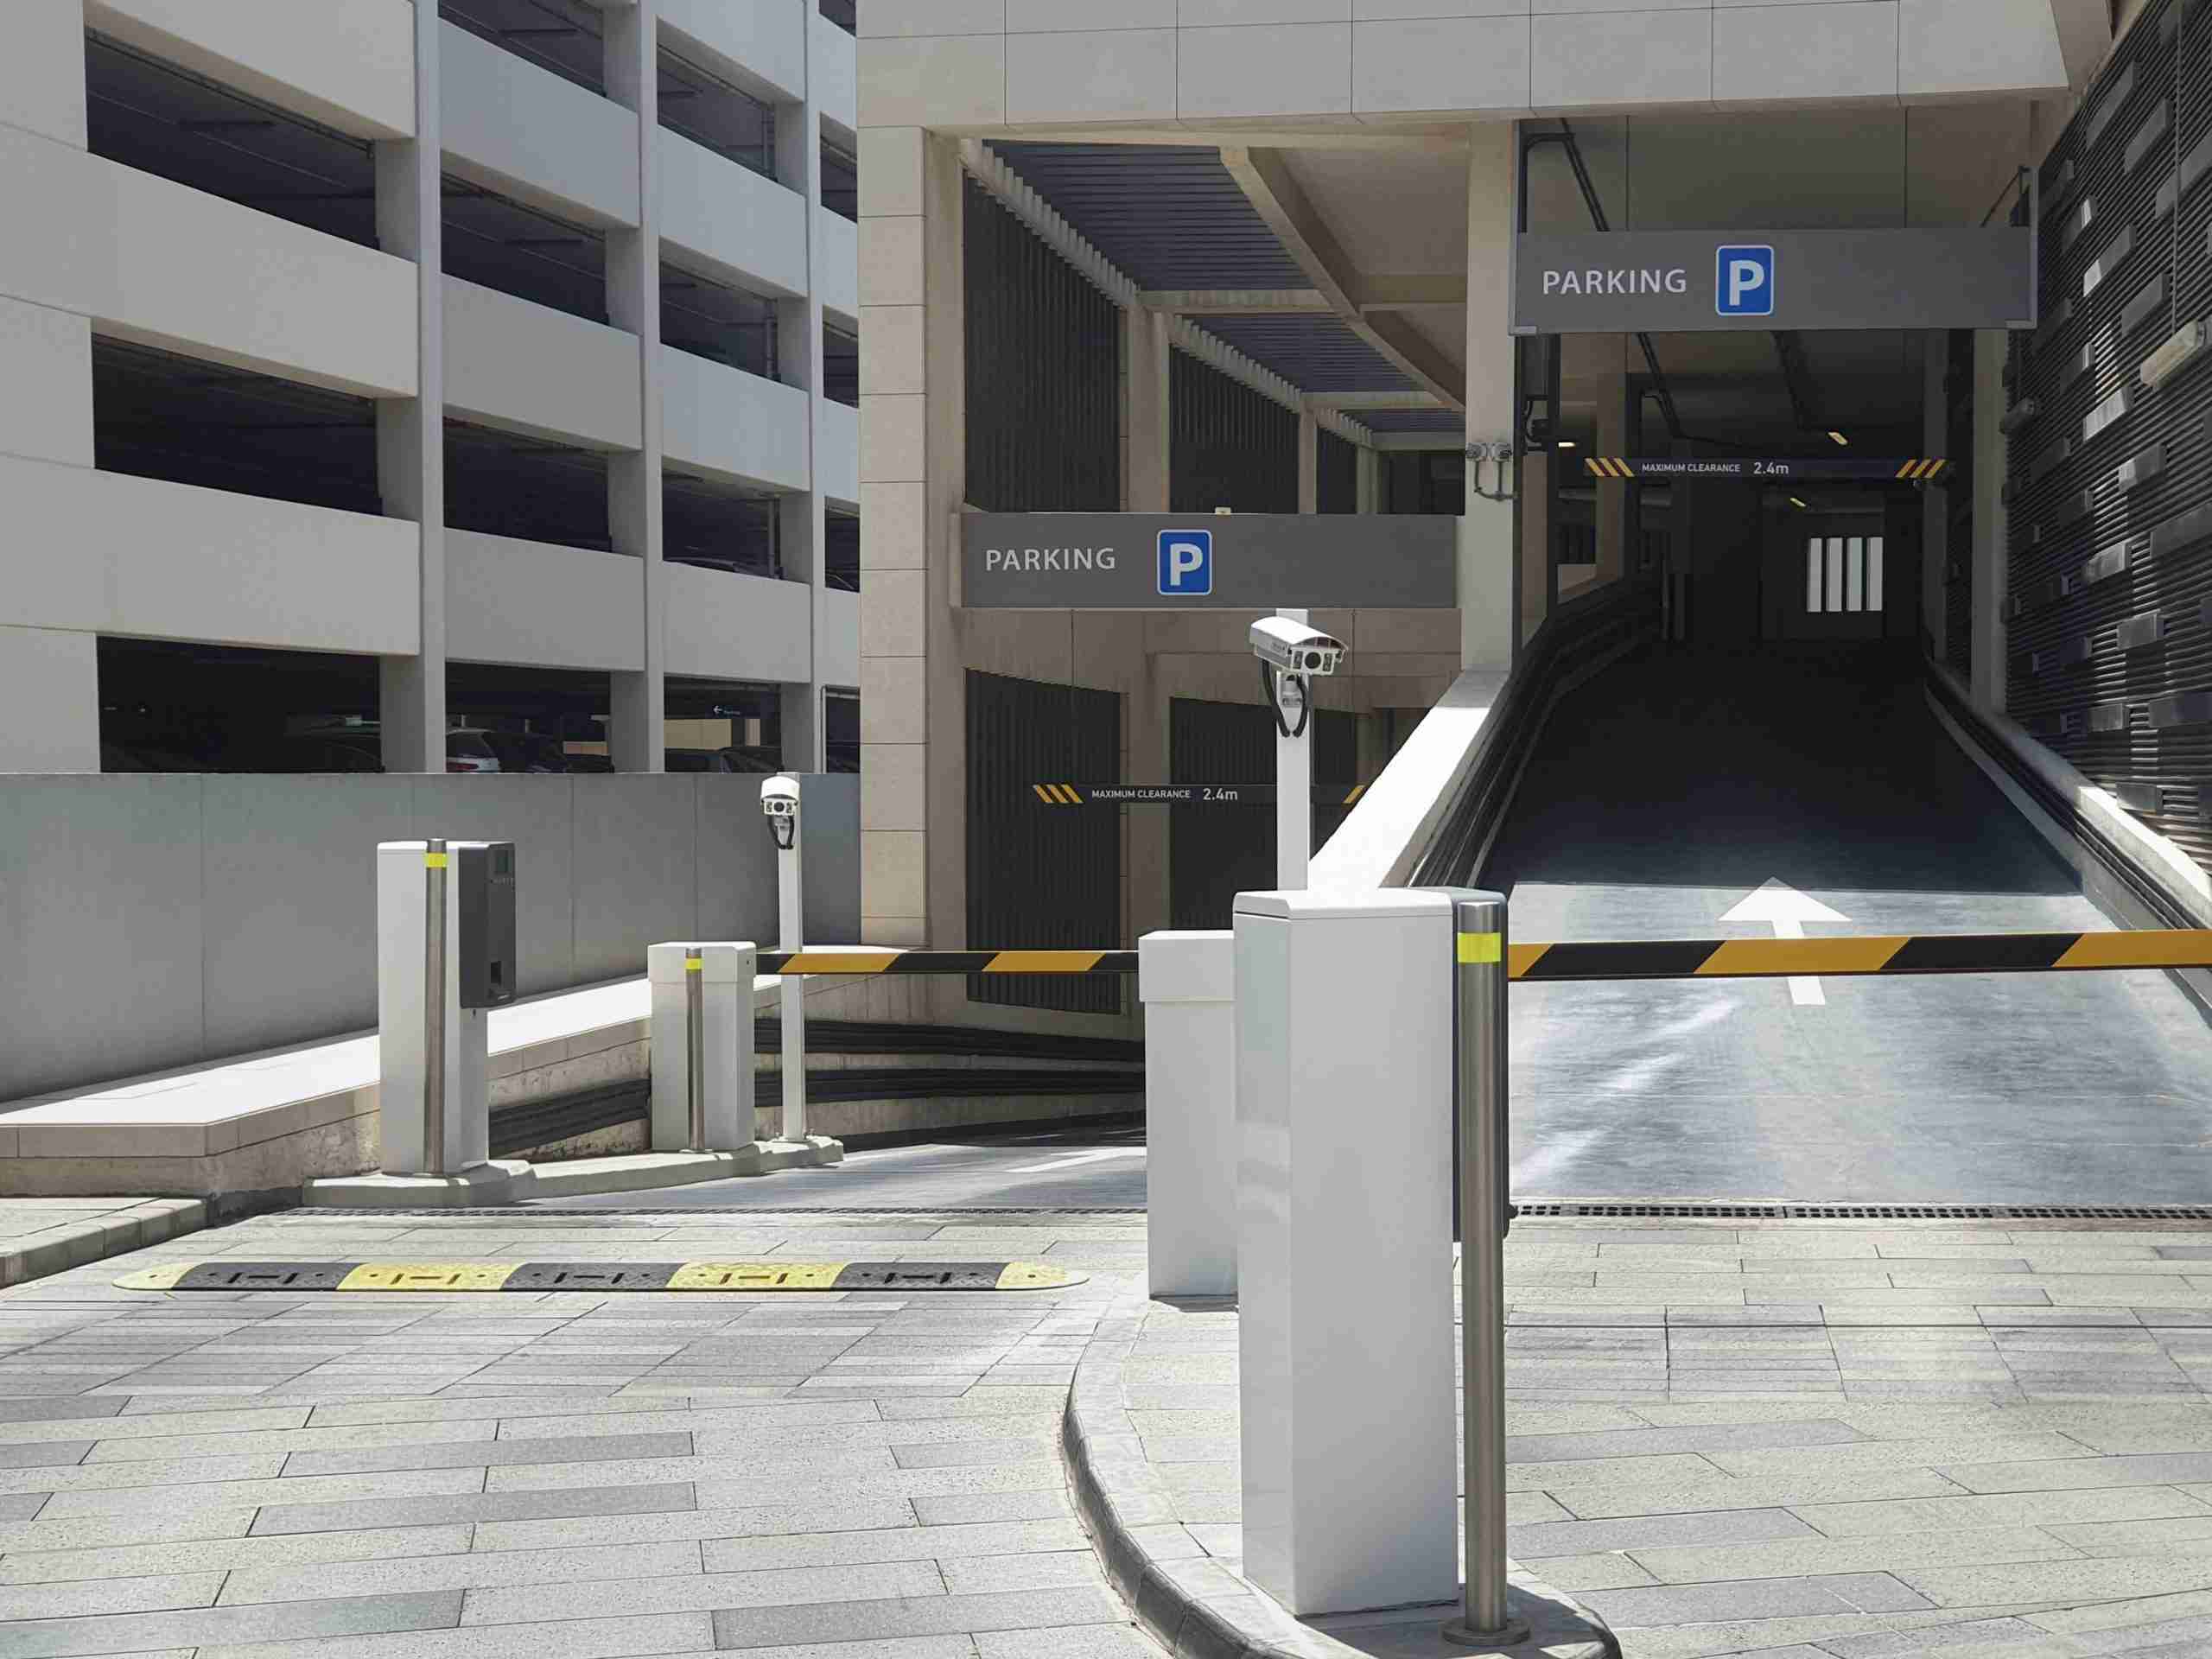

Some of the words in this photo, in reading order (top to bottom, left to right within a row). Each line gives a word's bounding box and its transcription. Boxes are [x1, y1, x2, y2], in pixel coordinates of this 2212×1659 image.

[1542, 269, 1687, 295] PARKING
[1728, 259, 1764, 306] P
[1642, 463, 1686, 473] MAXIMUM
[1687, 463, 1741, 473] CLEARANCE
[1753, 461, 1789, 474] 2.4m
[986, 547, 1116, 571] PARKING
[1169, 543, 1204, 586] P
[1091, 789, 1135, 799] MAXIMUM
[1137, 789, 1192, 799] CLEARANCE
[1203, 787, 1238, 800] 2.4m
